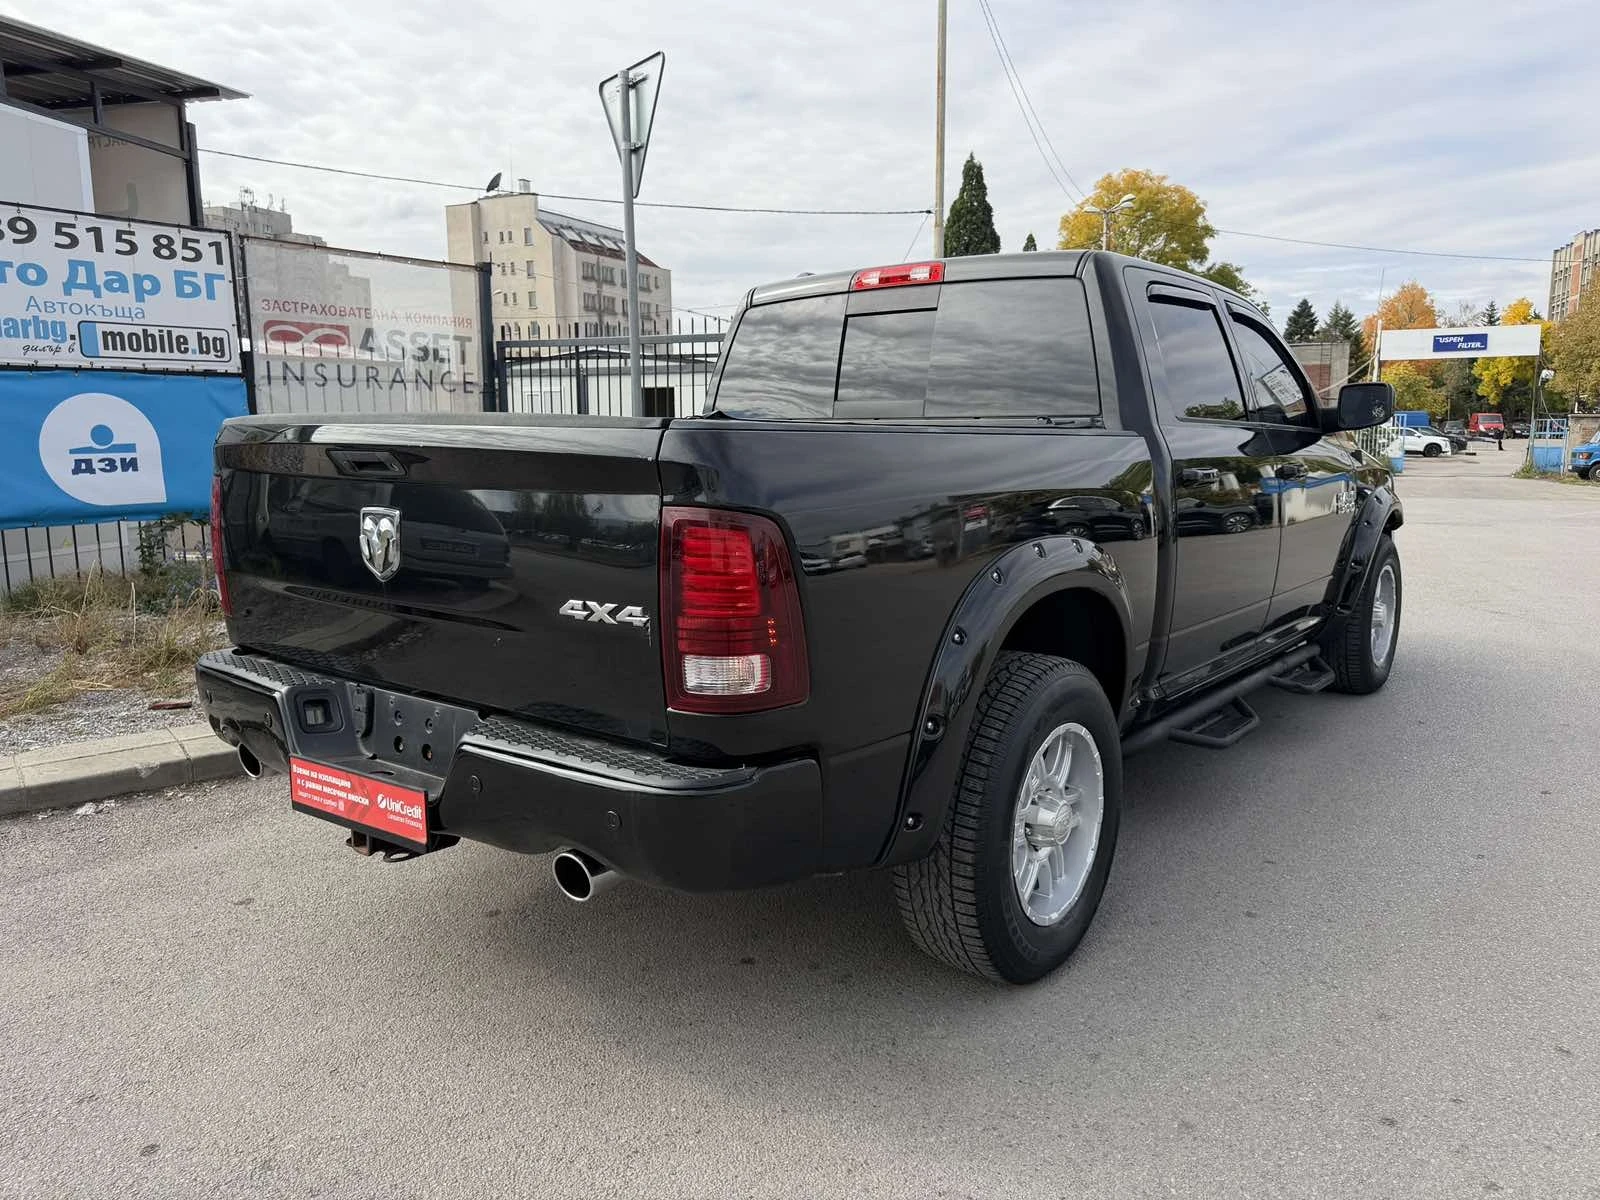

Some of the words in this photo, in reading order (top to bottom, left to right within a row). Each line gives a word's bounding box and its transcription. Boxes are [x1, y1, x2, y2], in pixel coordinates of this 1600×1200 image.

[0, 216, 37, 245] 9
[54, 221, 139, 256] 515
[152, 234, 224, 266] 851
[0, 260, 48, 287] то
[62, 259, 161, 303] Дар
[173, 270, 225, 301] БГ
[25, 296, 146, 321] Автокъща
[404, 310, 473, 329] КОМПАНИЯ
[0, 315, 76, 344] arbg.
[101, 328, 226, 359] mobile.bg
[359, 327, 473, 366] ASSET
[1457, 341, 1485, 349] FILTER
[265, 360, 475, 394] INSURANCE
[386, 797, 422, 820] UniCredit
